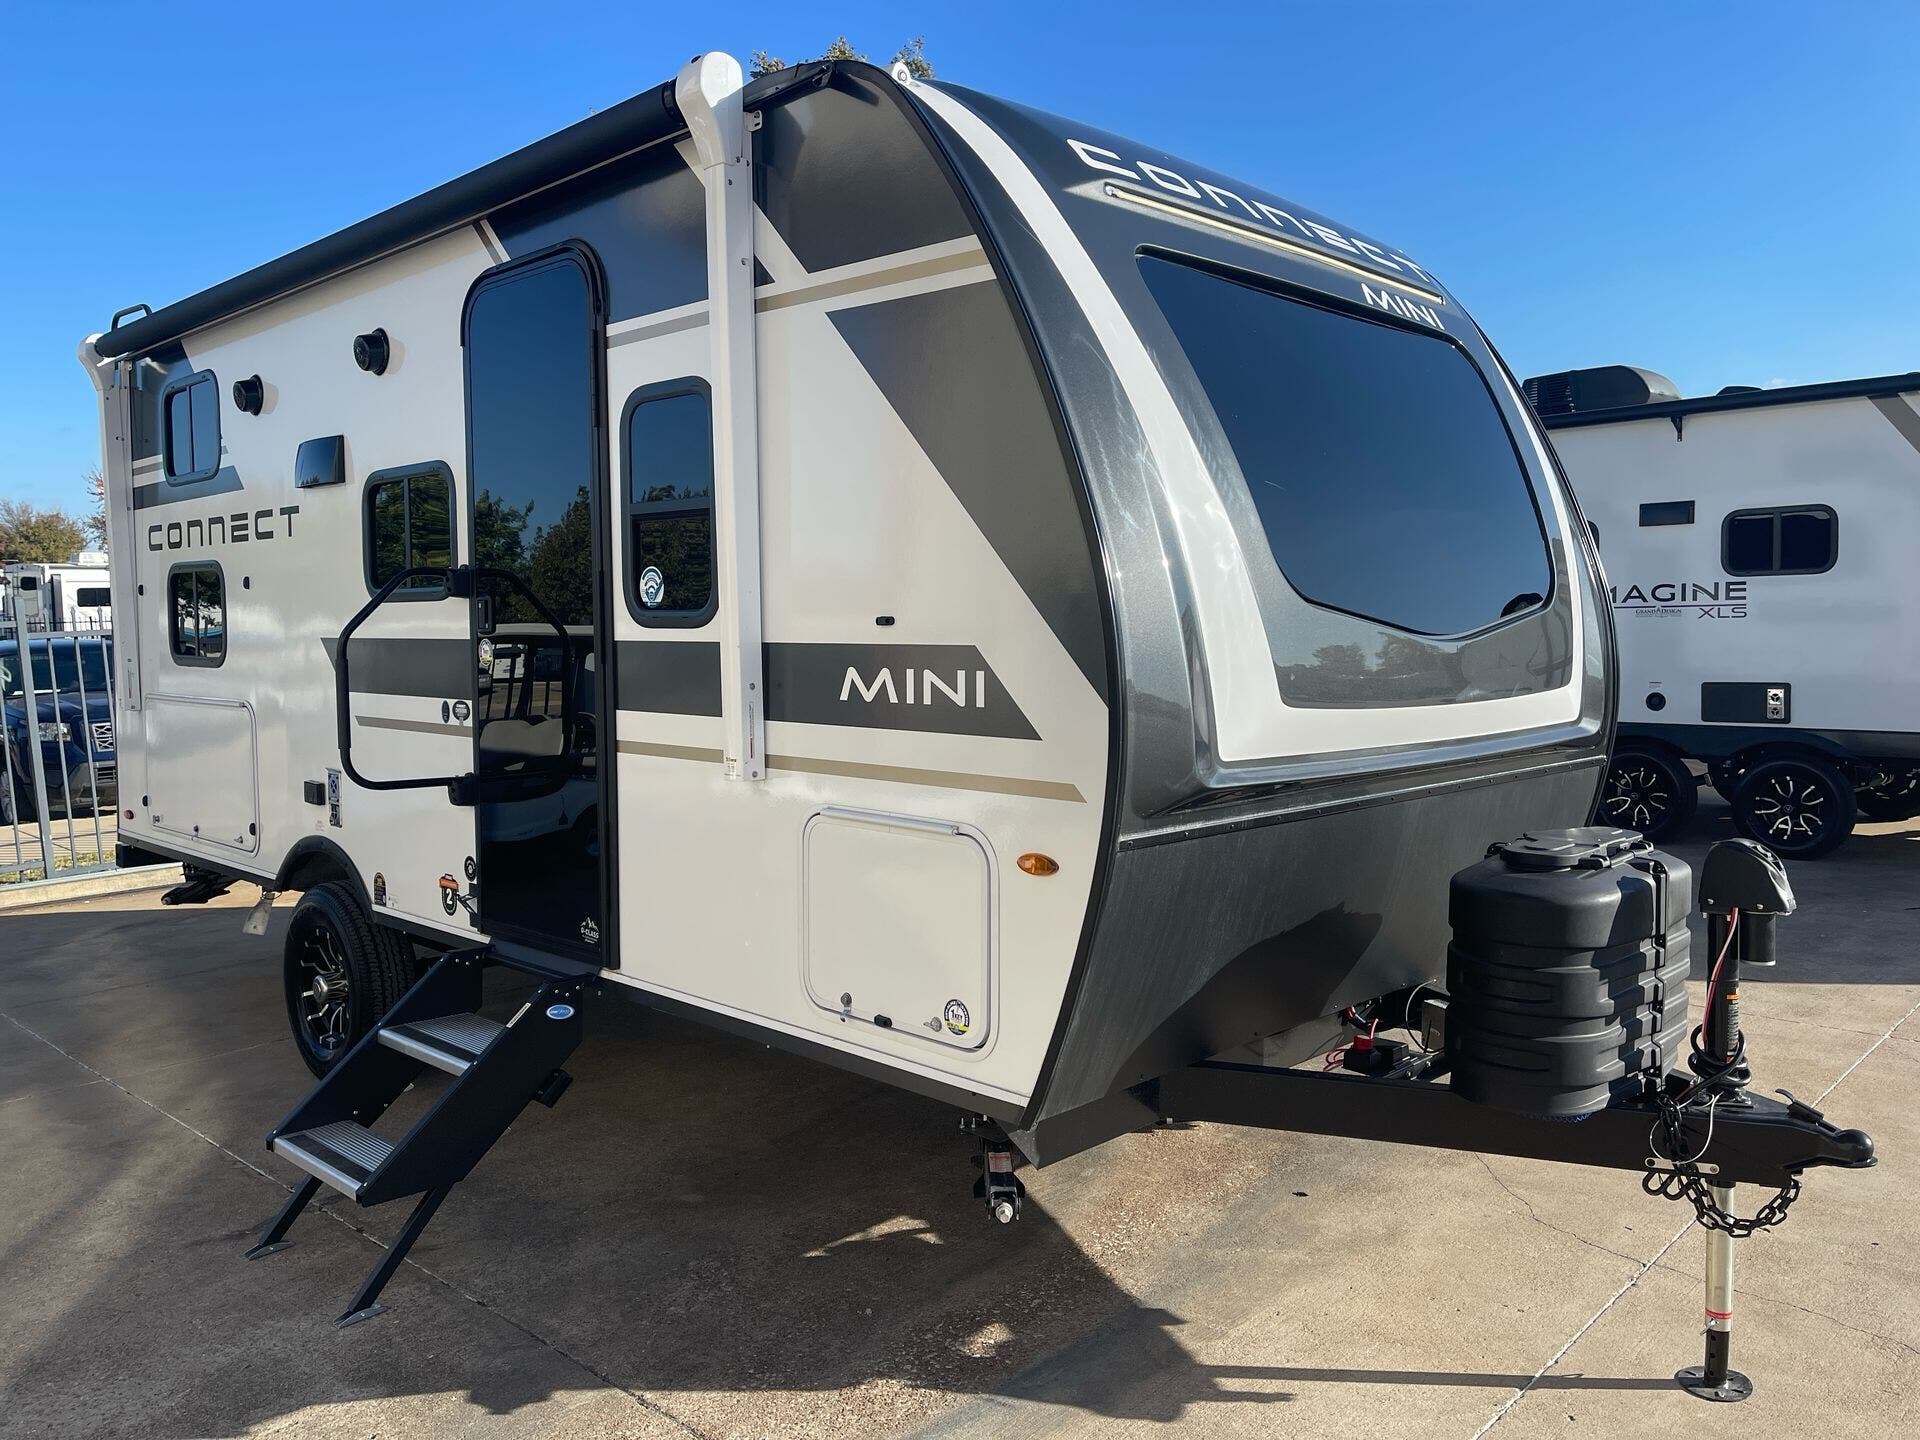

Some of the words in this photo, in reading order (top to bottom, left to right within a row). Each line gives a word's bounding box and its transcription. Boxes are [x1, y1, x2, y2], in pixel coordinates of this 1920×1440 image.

[1066, 138, 1431, 283] CONNECT
[1360, 282, 1446, 330] MINI
[148, 505, 300, 552] CONNECT
[1610, 581, 1747, 603] AGINE
[1698, 607, 1748, 619] XLS
[839, 666, 985, 708] MINI
[445, 888, 453, 905] 2
